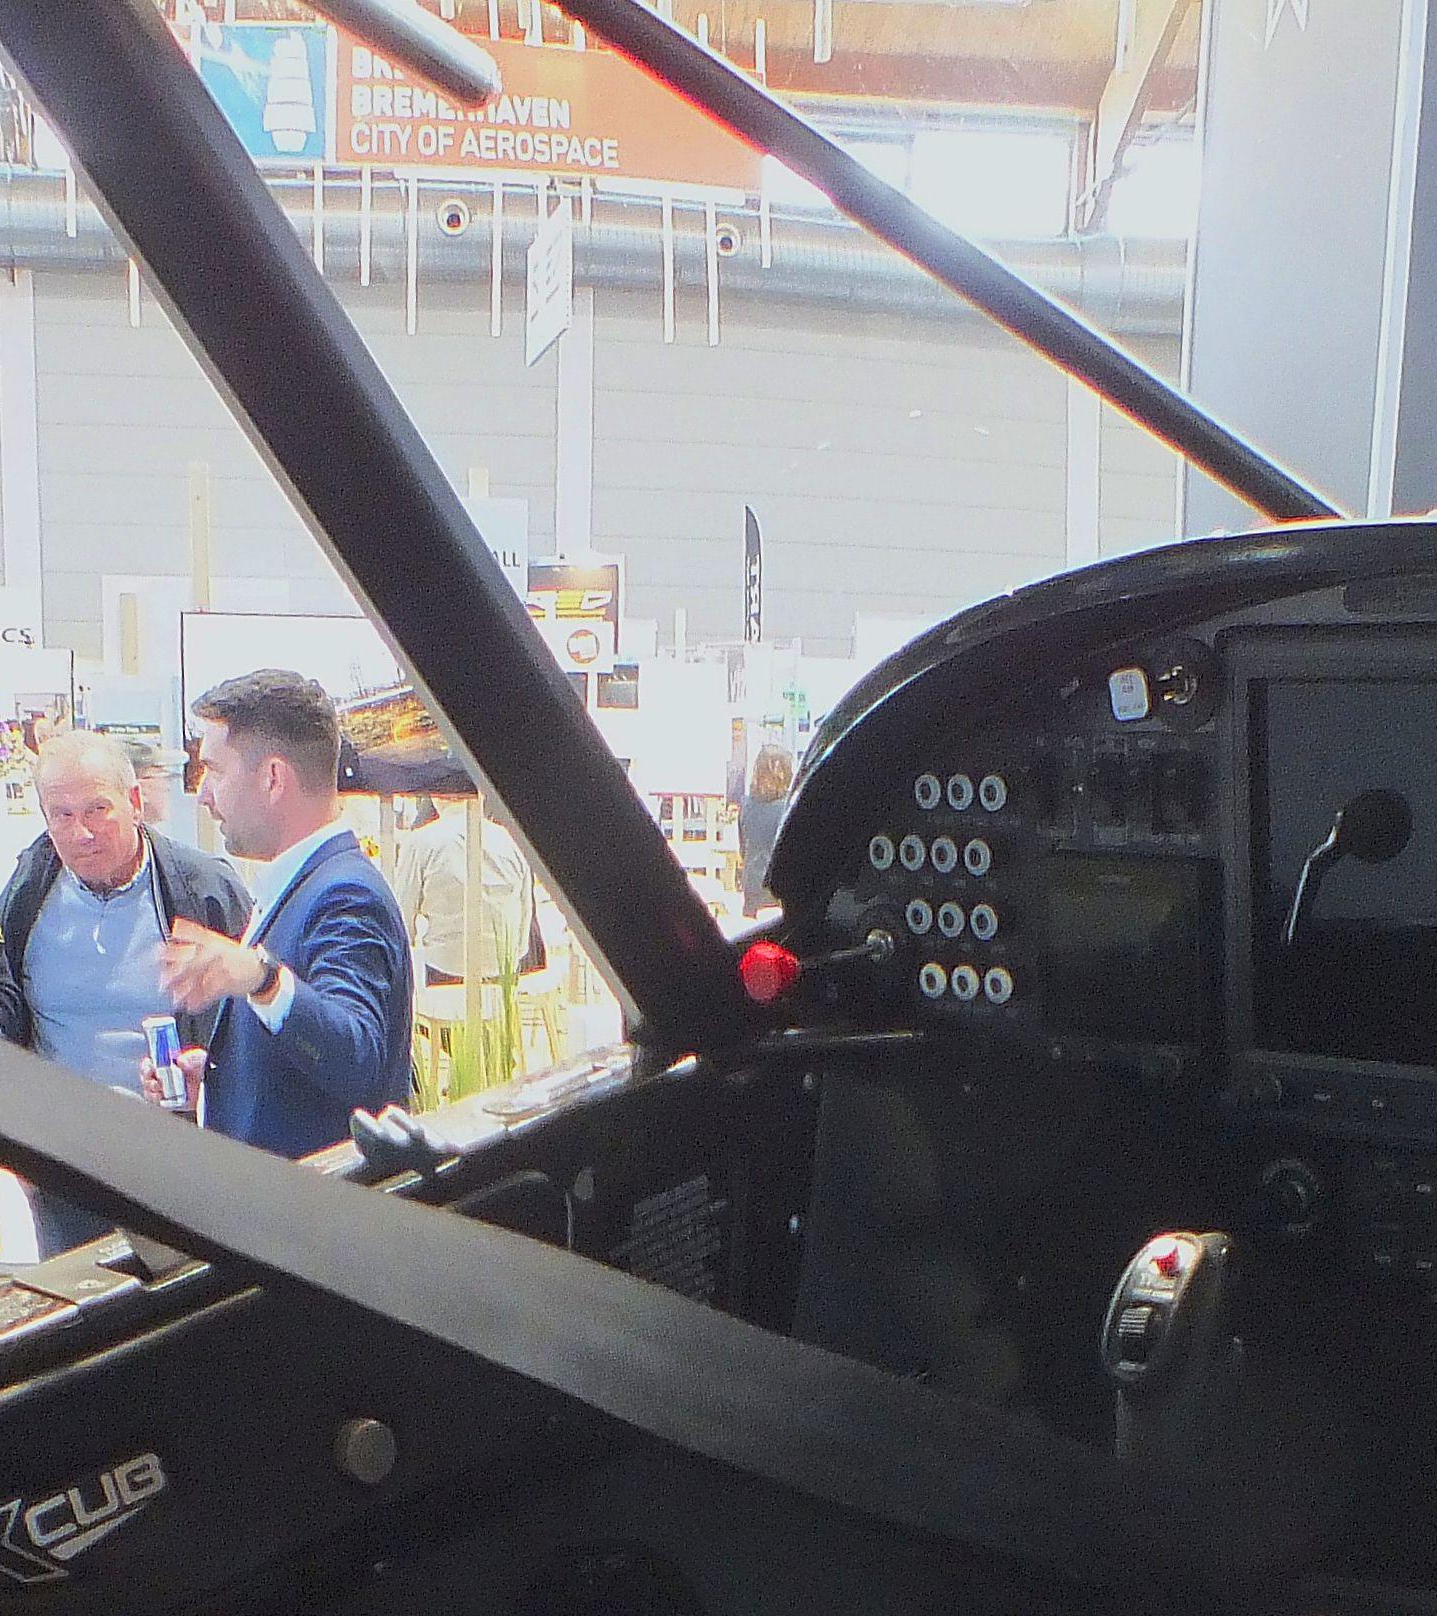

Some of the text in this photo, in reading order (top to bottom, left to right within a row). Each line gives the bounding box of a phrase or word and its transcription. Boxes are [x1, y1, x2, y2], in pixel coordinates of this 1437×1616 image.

[351, 122, 620, 168] CITY OF AEROSPACE
